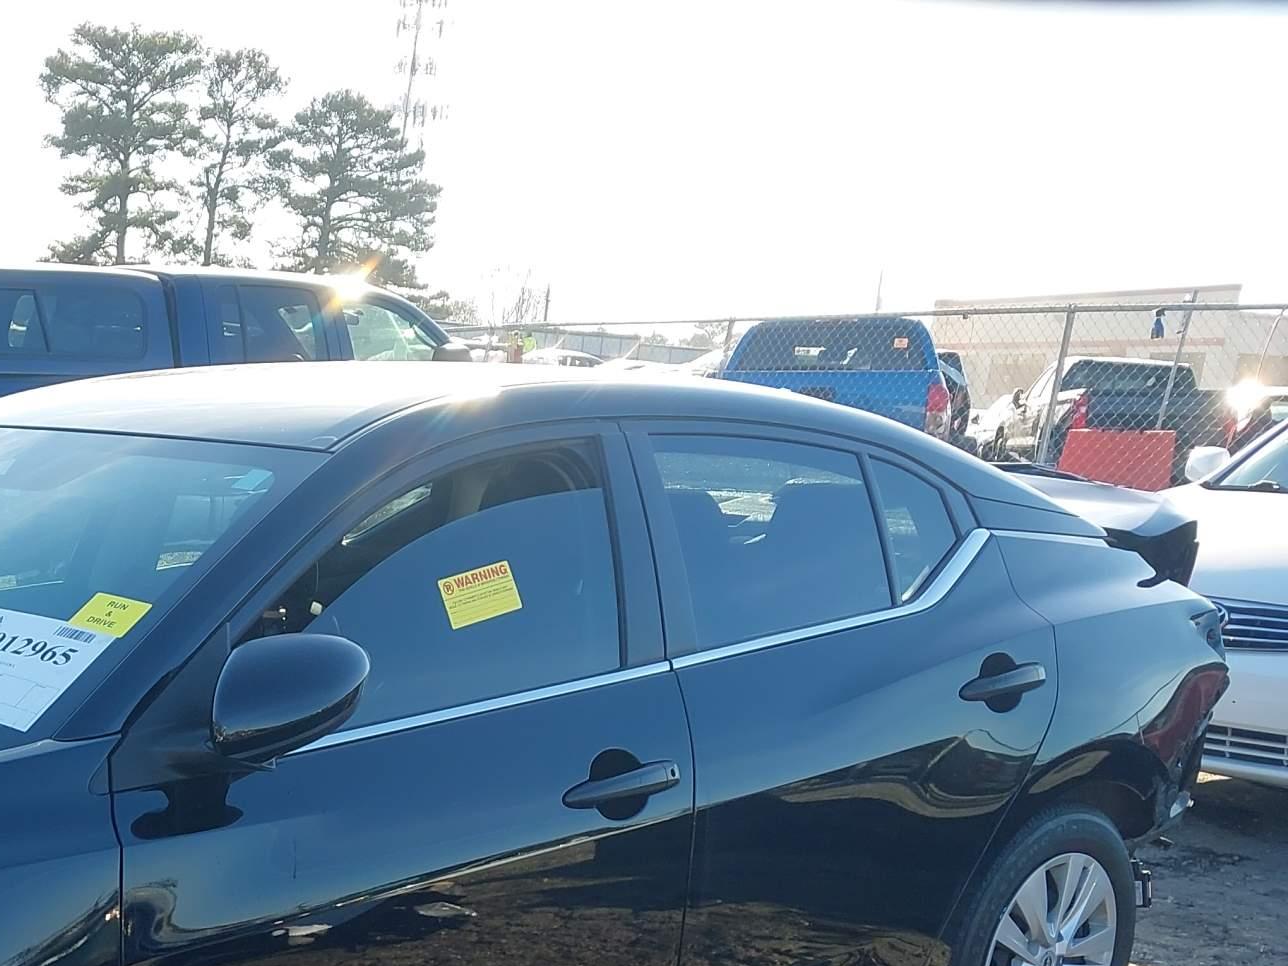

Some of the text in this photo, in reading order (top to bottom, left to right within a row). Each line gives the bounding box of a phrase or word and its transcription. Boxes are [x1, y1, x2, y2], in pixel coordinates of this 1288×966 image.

[453, 564, 509, 589] WARNING
[106, 600, 130, 611] RUN
[86, 616, 117, 629] DRIVE
